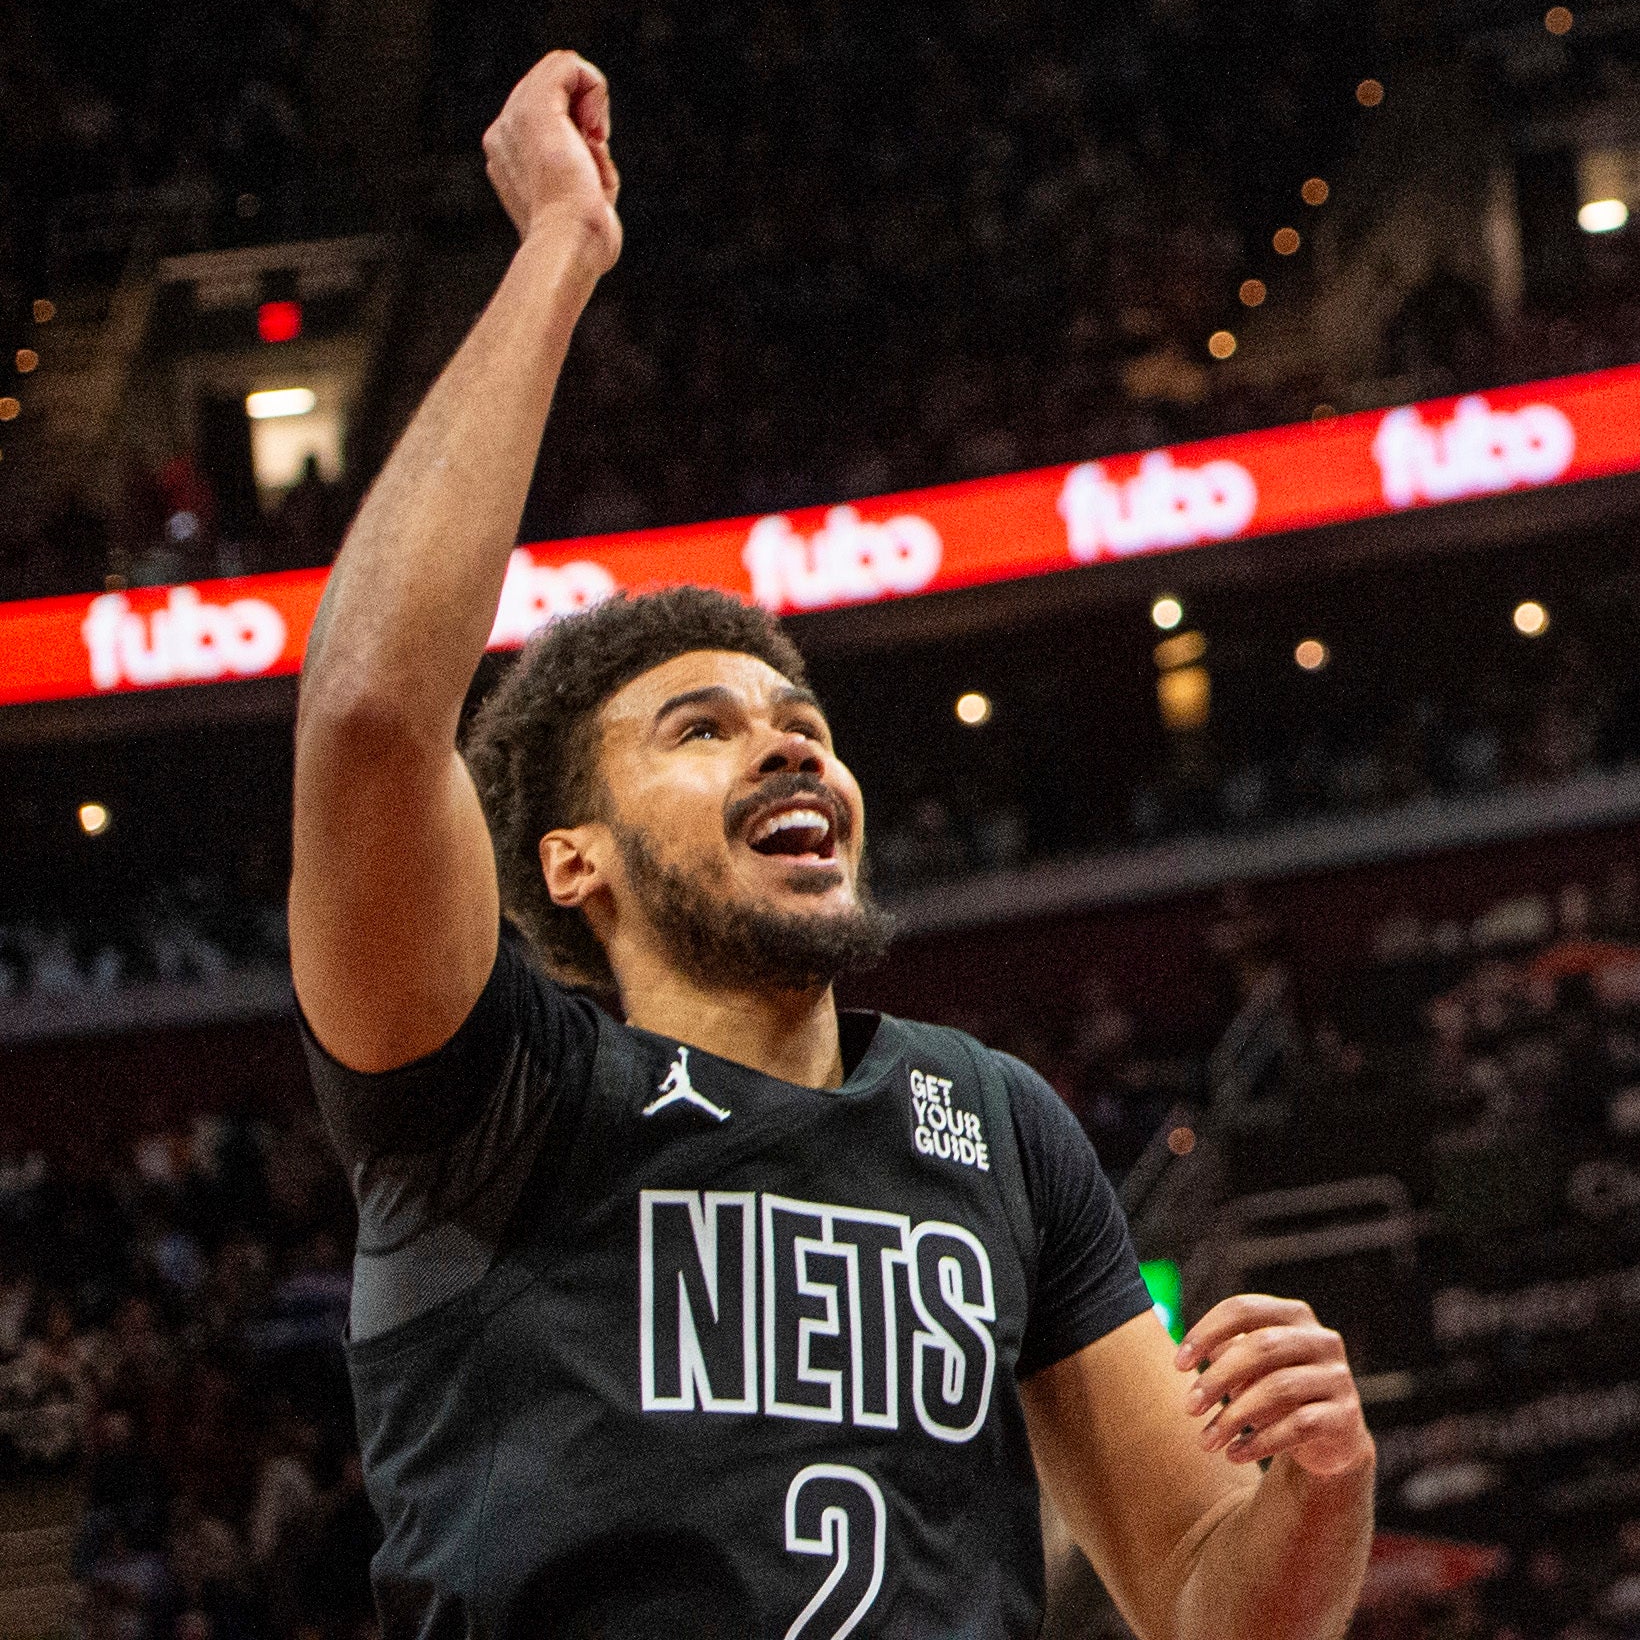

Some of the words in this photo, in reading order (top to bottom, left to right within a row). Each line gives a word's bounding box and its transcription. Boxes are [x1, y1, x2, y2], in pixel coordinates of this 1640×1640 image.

[82, 586, 286, 691] fubo
[742, 505, 943, 614] fubo
[1057, 450, 1258, 562] fubo
[1373, 393, 1576, 509] fubo
[910, 1069, 953, 1109] GET
[913, 1099, 982, 1143] YOUR
[914, 1126, 990, 1172] GUIDE
[639, 1188, 997, 1443] NETS
[785, 1464, 887, 1640] 2
